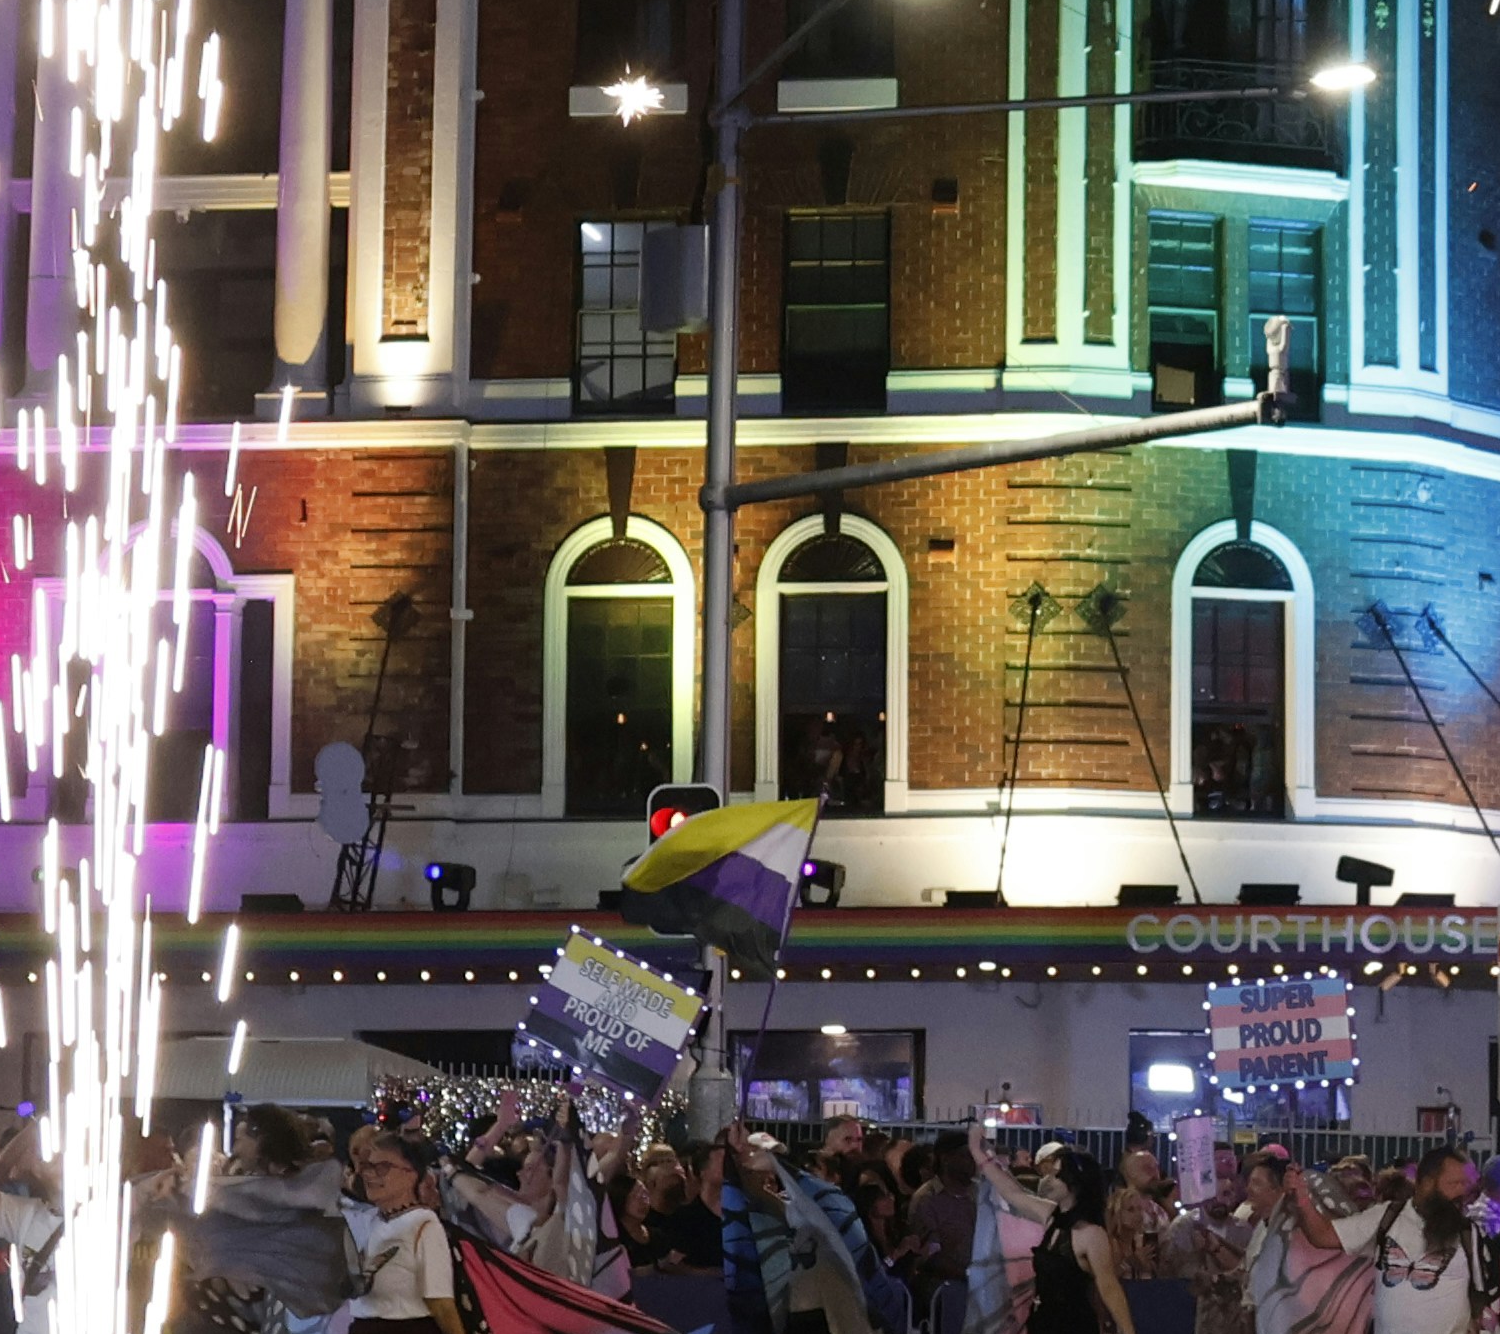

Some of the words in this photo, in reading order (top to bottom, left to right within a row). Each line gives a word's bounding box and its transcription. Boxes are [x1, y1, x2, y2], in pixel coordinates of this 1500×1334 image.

[1125, 913, 1499, 955] COURTHOUSE
[594, 989, 638, 1022] AND
[618, 977, 675, 1018] MADE
[1239, 983, 1315, 1014] SUPER
[563, 997, 625, 1040] PROUD
[625, 1029, 653, 1053] OF
[1239, 1017, 1322, 1049] PROUD
[581, 1029, 614, 1058] ME
[1238, 1050, 1328, 1082] PARENT
